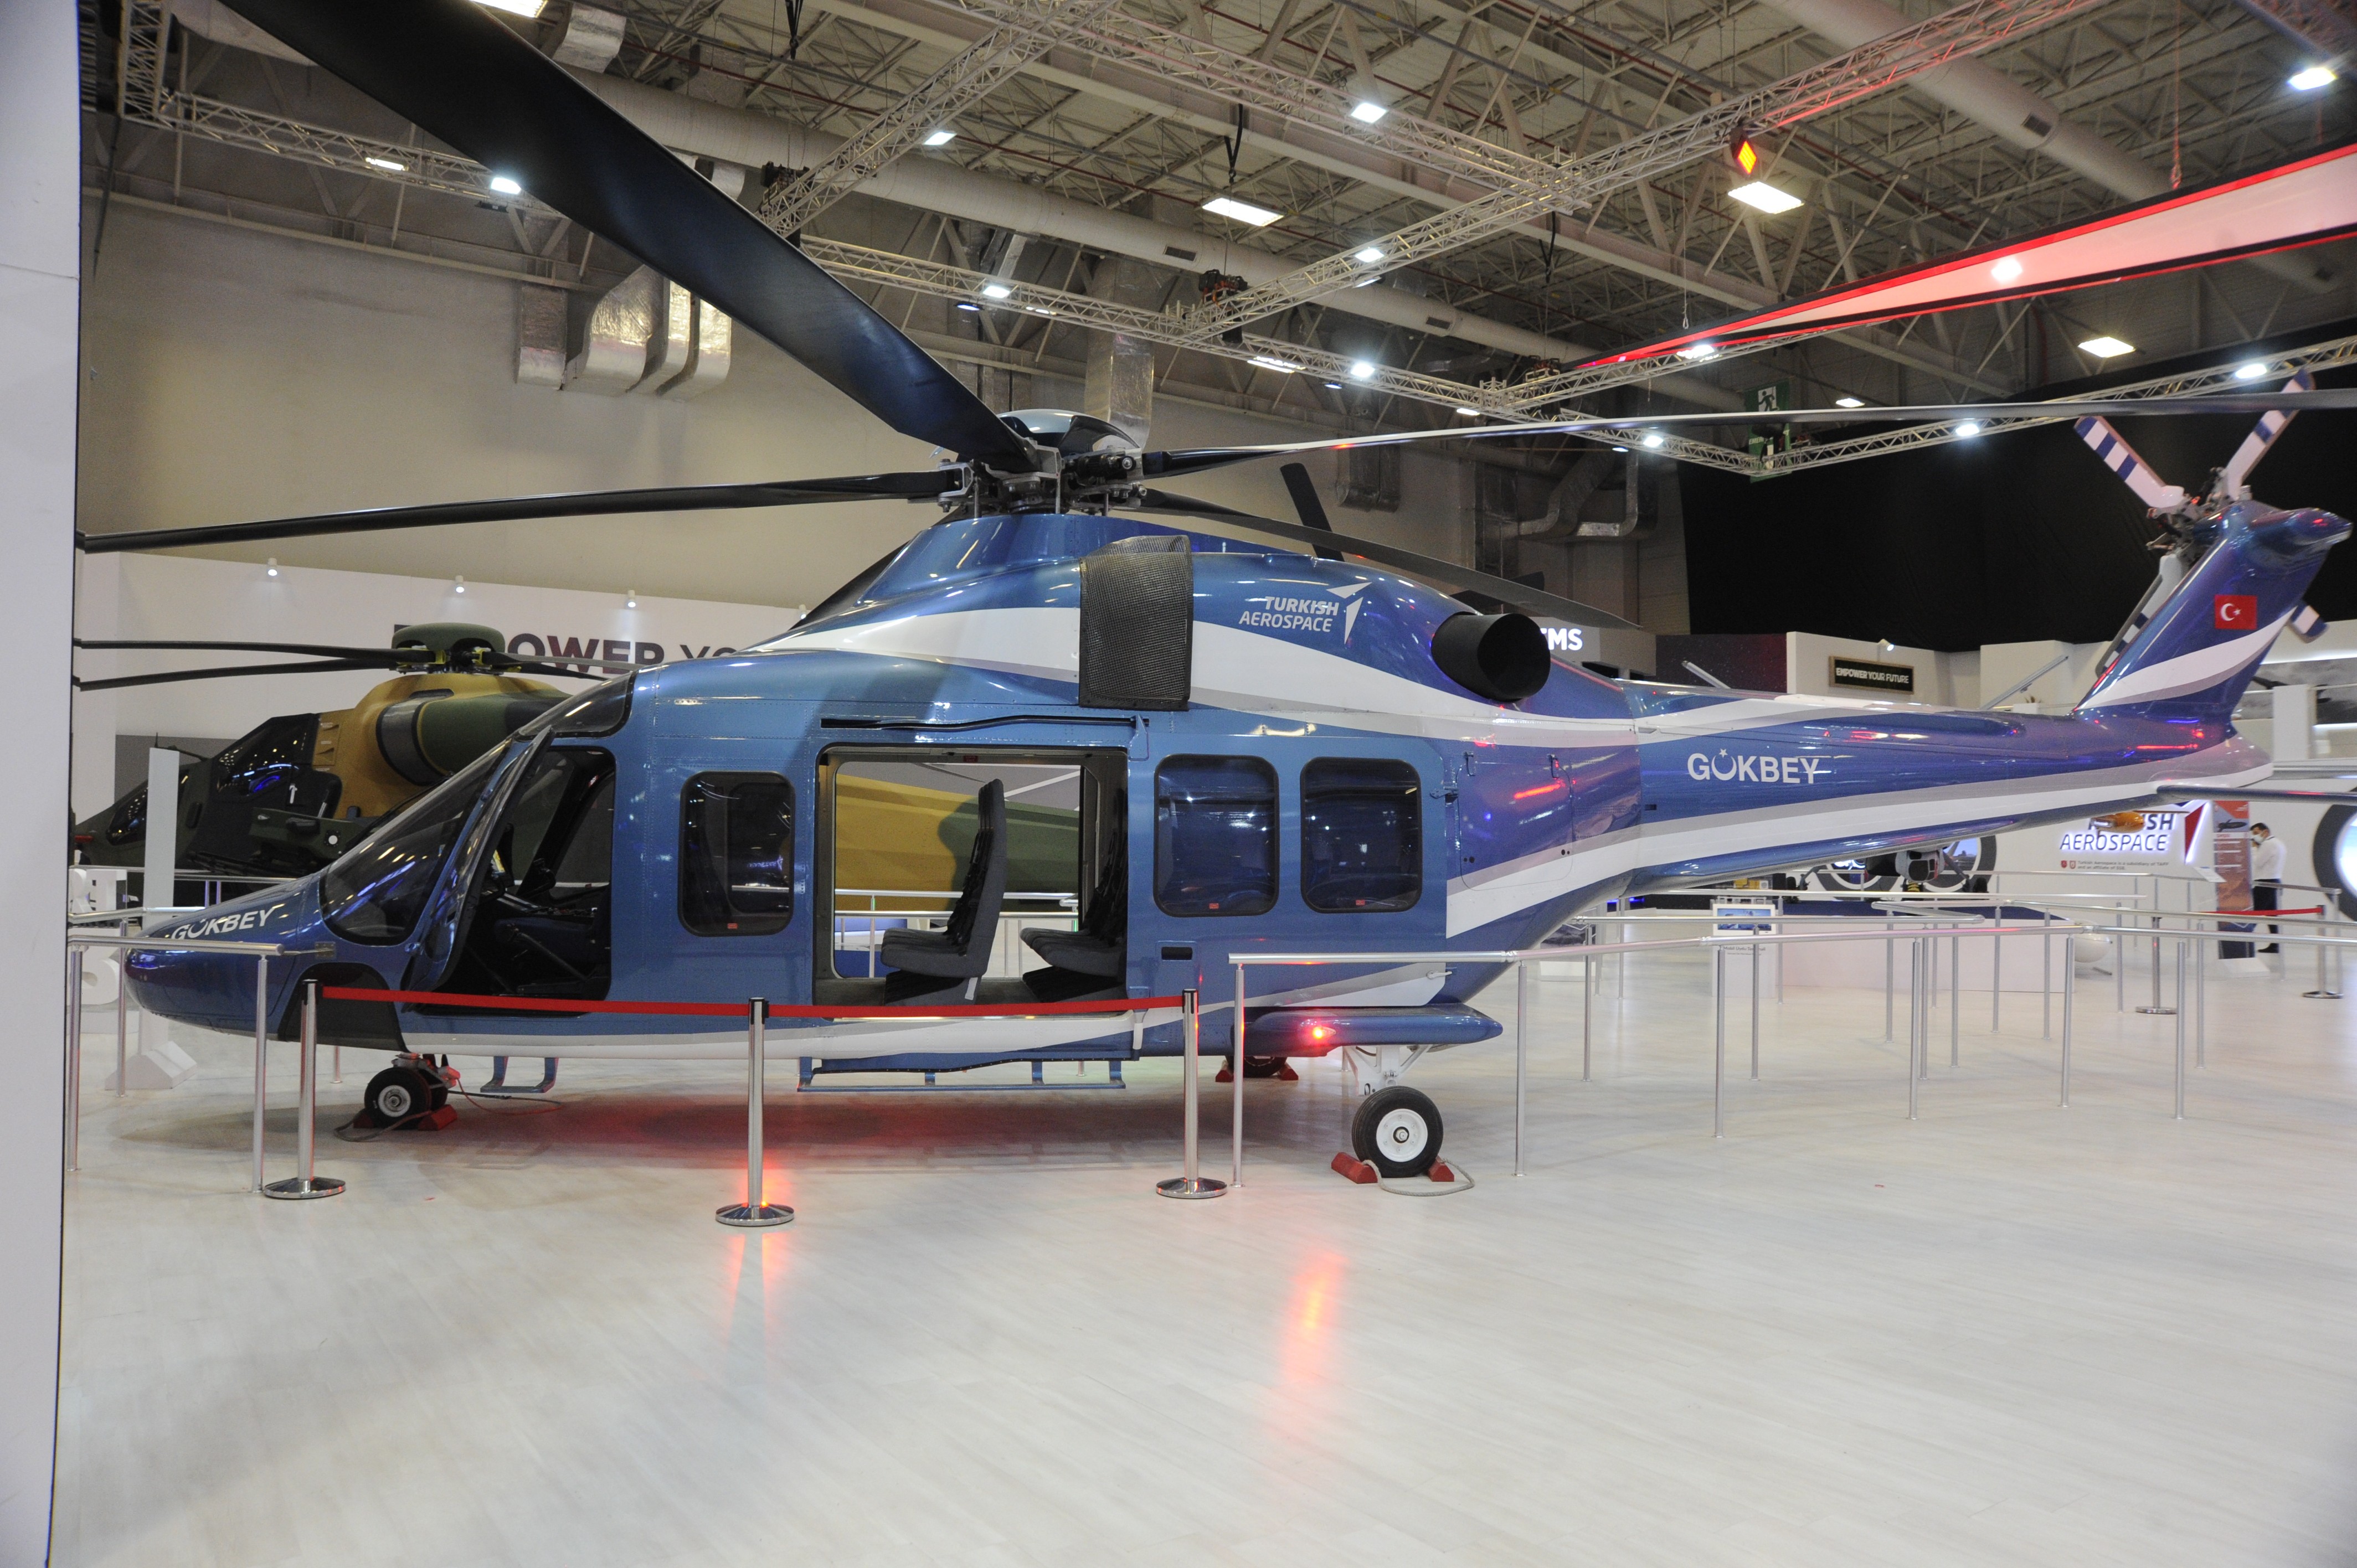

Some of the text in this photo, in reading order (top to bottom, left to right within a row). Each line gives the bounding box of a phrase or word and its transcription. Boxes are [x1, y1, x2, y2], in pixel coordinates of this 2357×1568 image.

[1265, 596, 1340, 616] TURKISH
[1239, 611, 1333, 632] AEROSPACE
[1836, 668, 1910, 684] EMPOWER YOUR FUTURE
[2060, 834, 2168, 851] AEROSPACE
